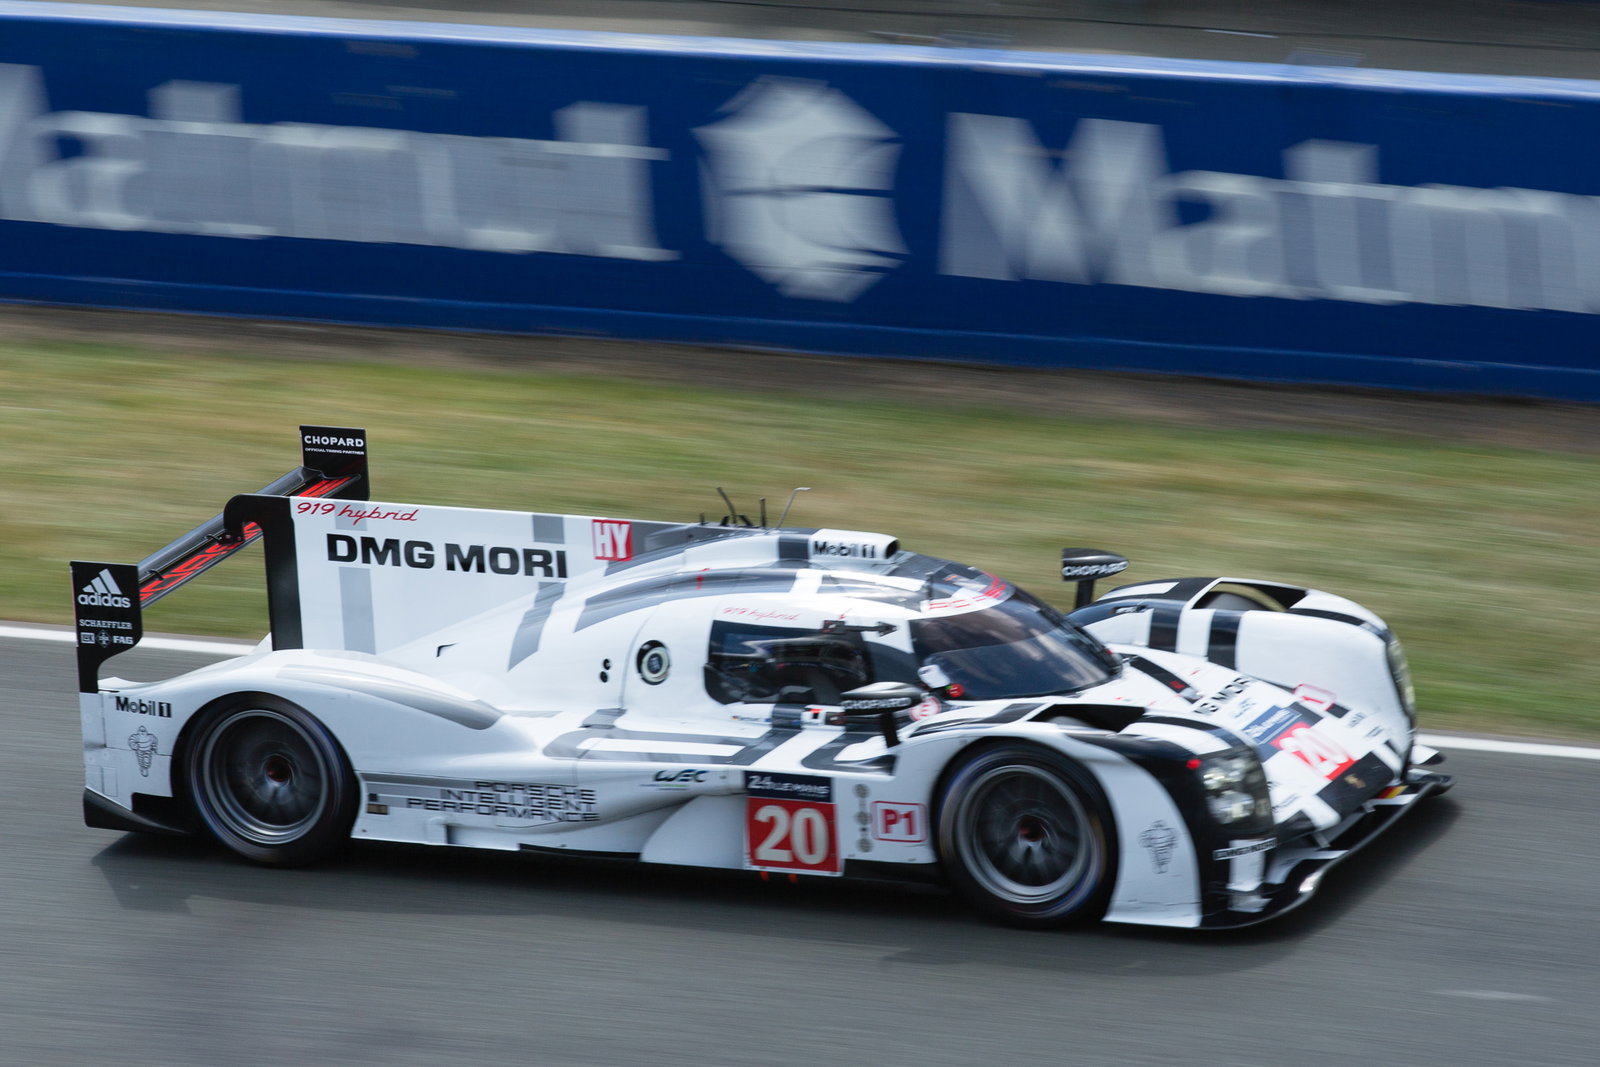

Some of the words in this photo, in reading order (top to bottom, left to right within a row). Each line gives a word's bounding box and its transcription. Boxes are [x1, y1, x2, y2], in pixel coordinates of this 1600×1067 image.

[304, 435, 364, 447] CHOPARD
[297, 502, 336, 515] 919
[337, 504, 419, 526] hybrid
[594, 522, 631, 559] HY
[814, 540, 859, 558] Mobil
[326, 533, 435, 569] DMG
[444, 542, 568, 578] MORI
[1062, 561, 1129, 576] CHOPARD
[78, 592, 131, 608] adidas
[79, 618, 133, 630] SCHAEFFLER
[112, 635, 134, 645] FAG
[115, 695, 156, 717] Mobil
[653, 768, 709, 782] WEC
[440, 788, 598, 812] INTELLIGENT
[474, 781, 597, 801] PORSCHE
[406, 797, 602, 823] PERFORMANCE
[880, 808, 916, 836] P1
[754, 804, 830, 866] 20
